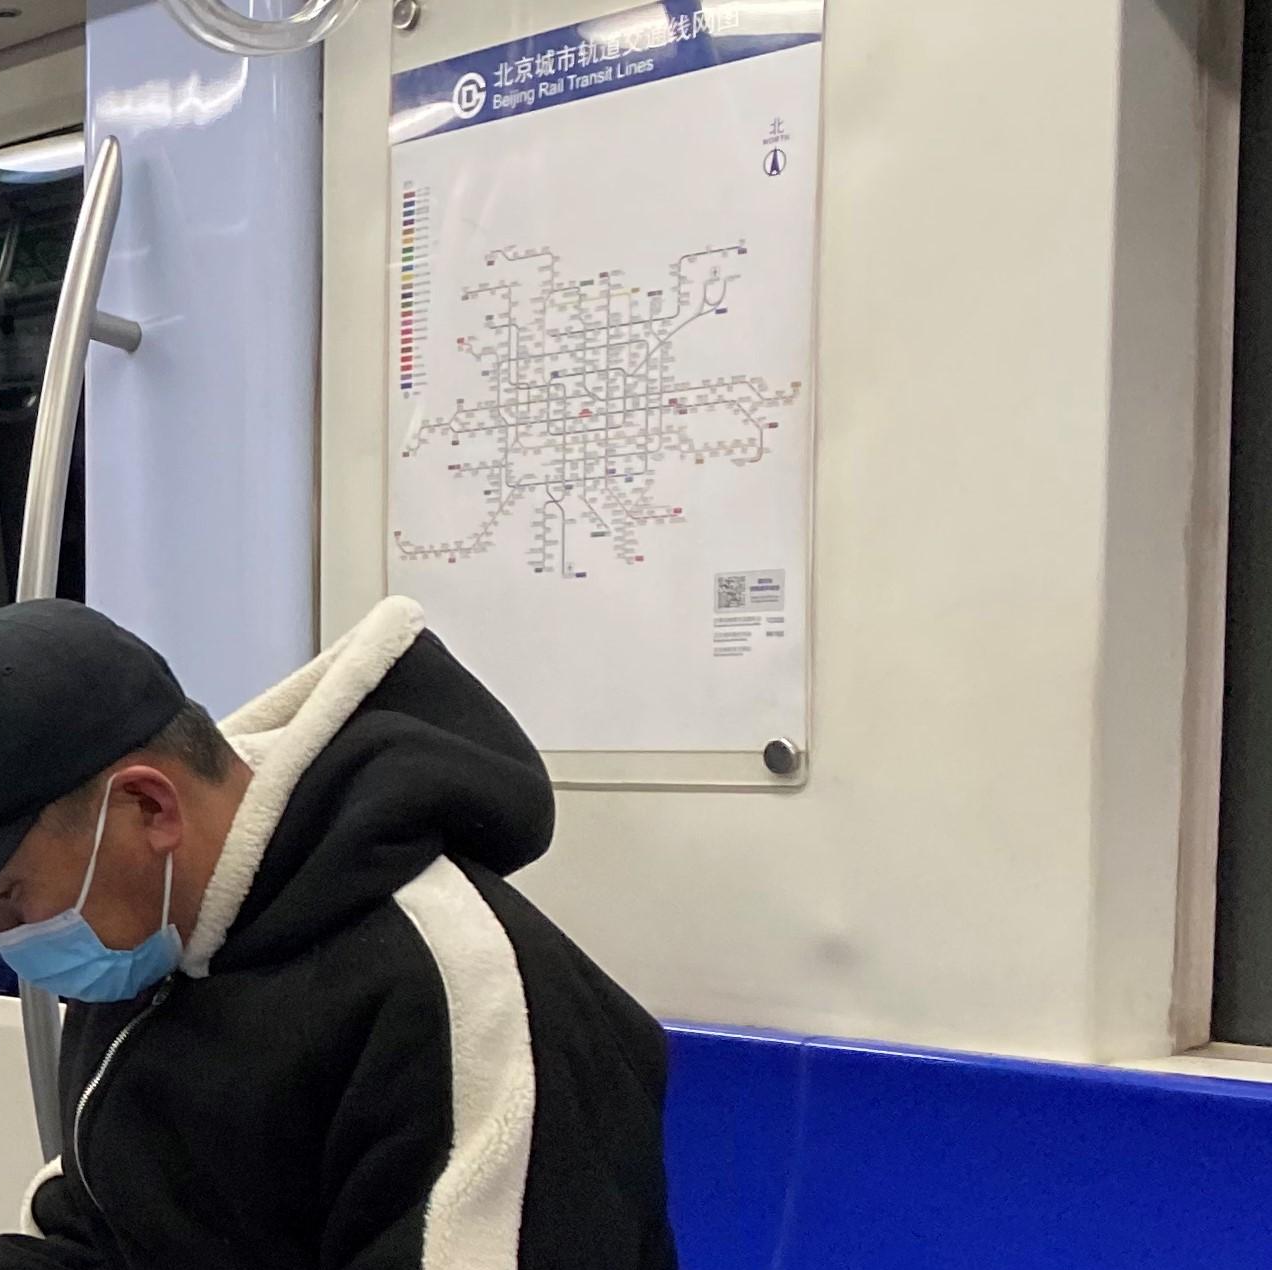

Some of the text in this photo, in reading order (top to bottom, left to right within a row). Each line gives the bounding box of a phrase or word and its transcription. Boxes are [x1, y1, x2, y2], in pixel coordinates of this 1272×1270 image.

[492, 57, 654, 110] Beijing Rail Transit Lines
